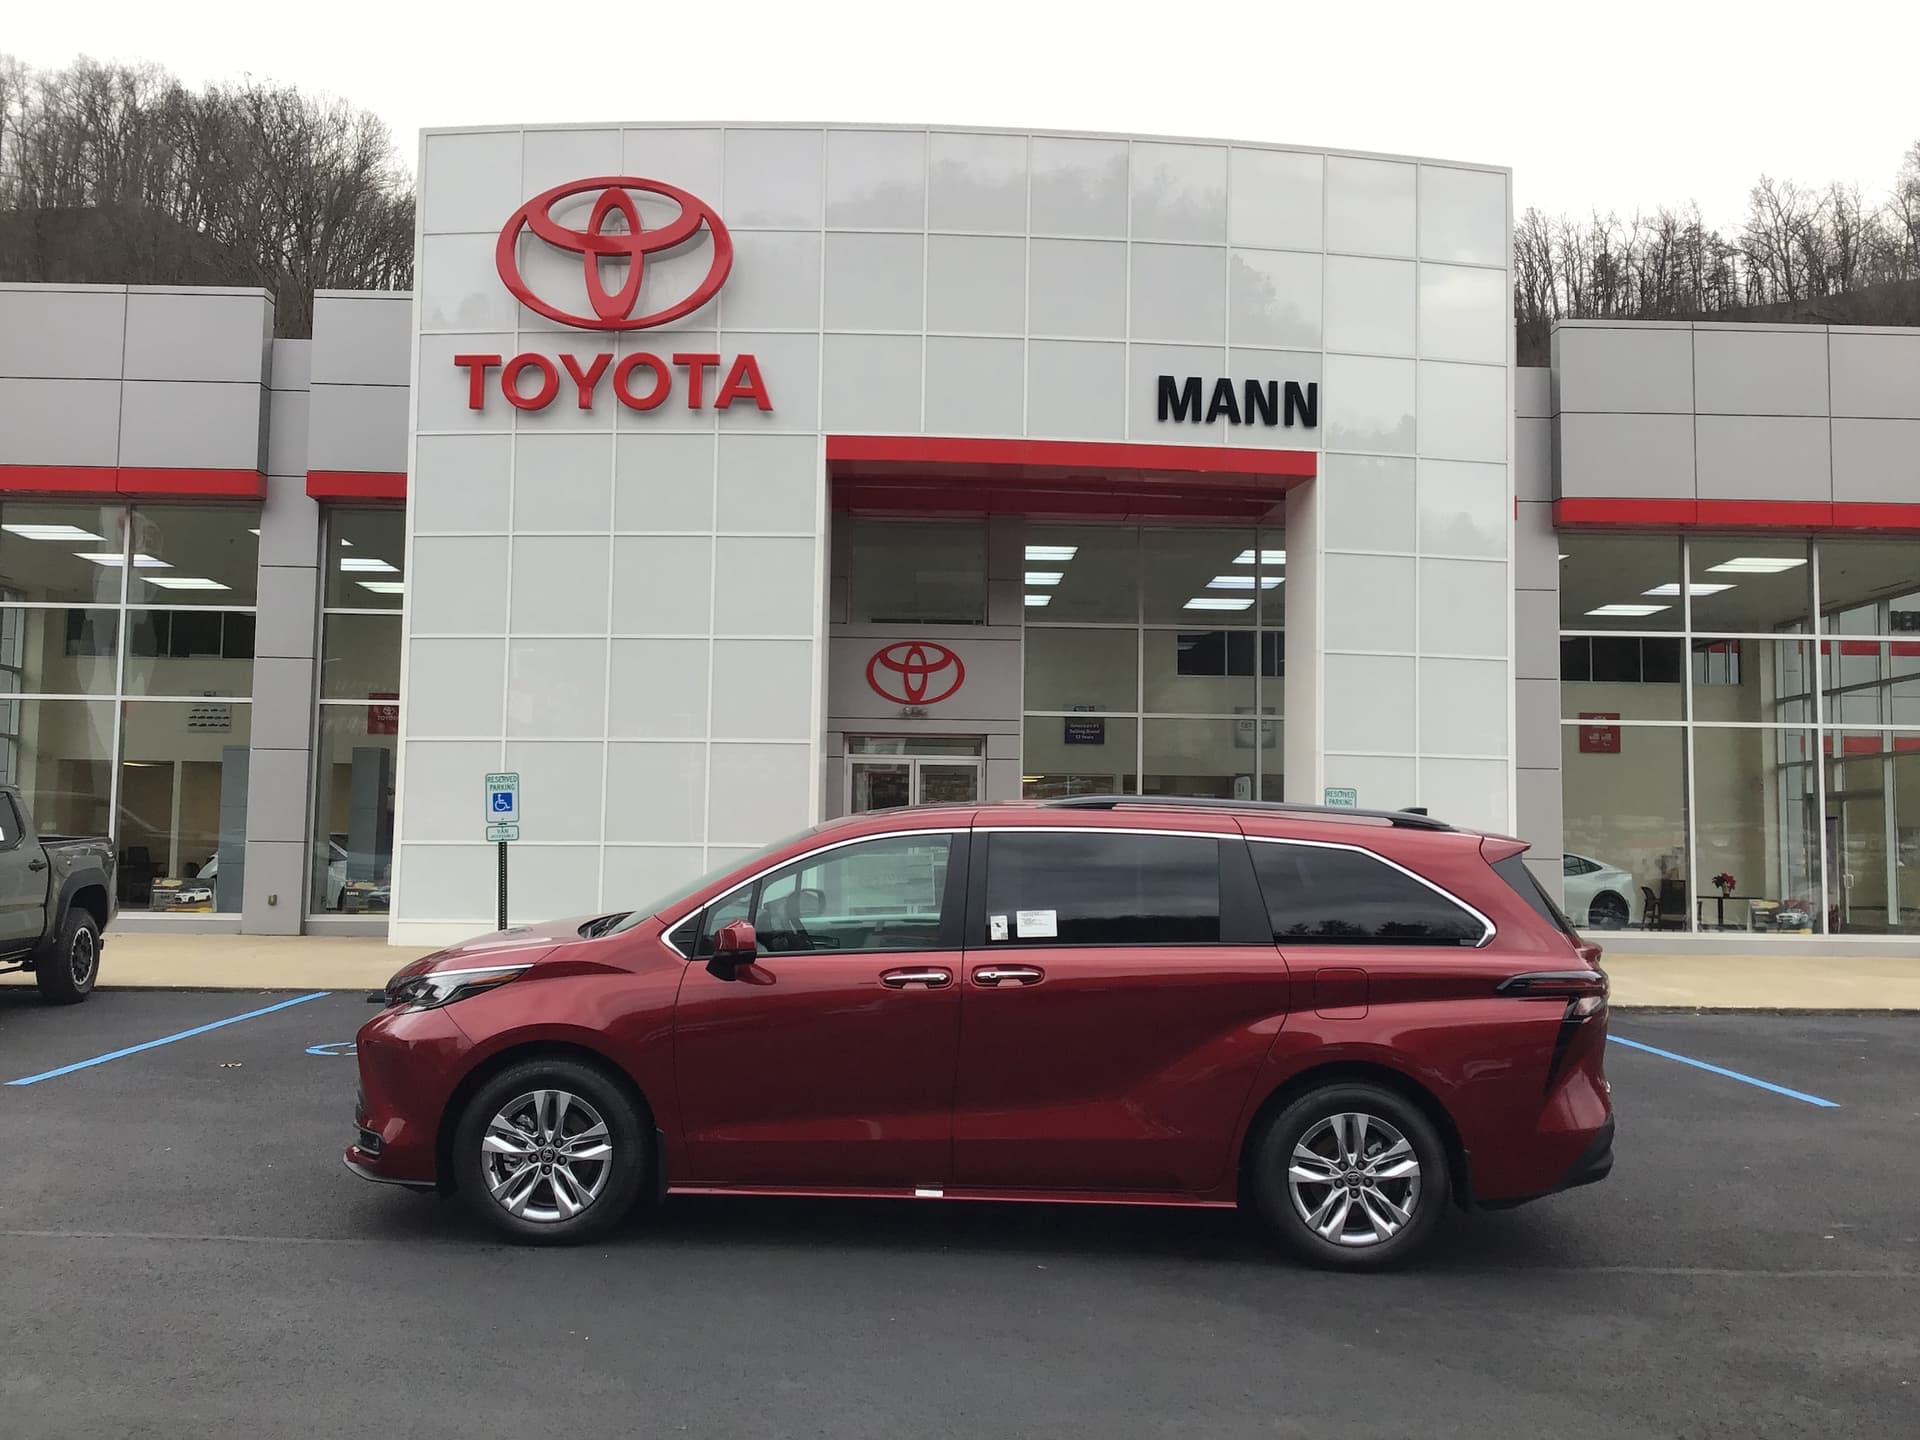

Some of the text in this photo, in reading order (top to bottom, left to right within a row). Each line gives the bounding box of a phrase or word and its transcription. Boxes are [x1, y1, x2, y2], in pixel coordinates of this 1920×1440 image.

[453, 351, 774, 412] TOYOTA
[1157, 375, 1318, 428] MANN
[487, 775, 518, 783] RESERVED
[489, 783, 516, 791] PARKING
[1327, 790, 1355, 799] RESERVED
[1328, 798, 1353, 806] PARKING
